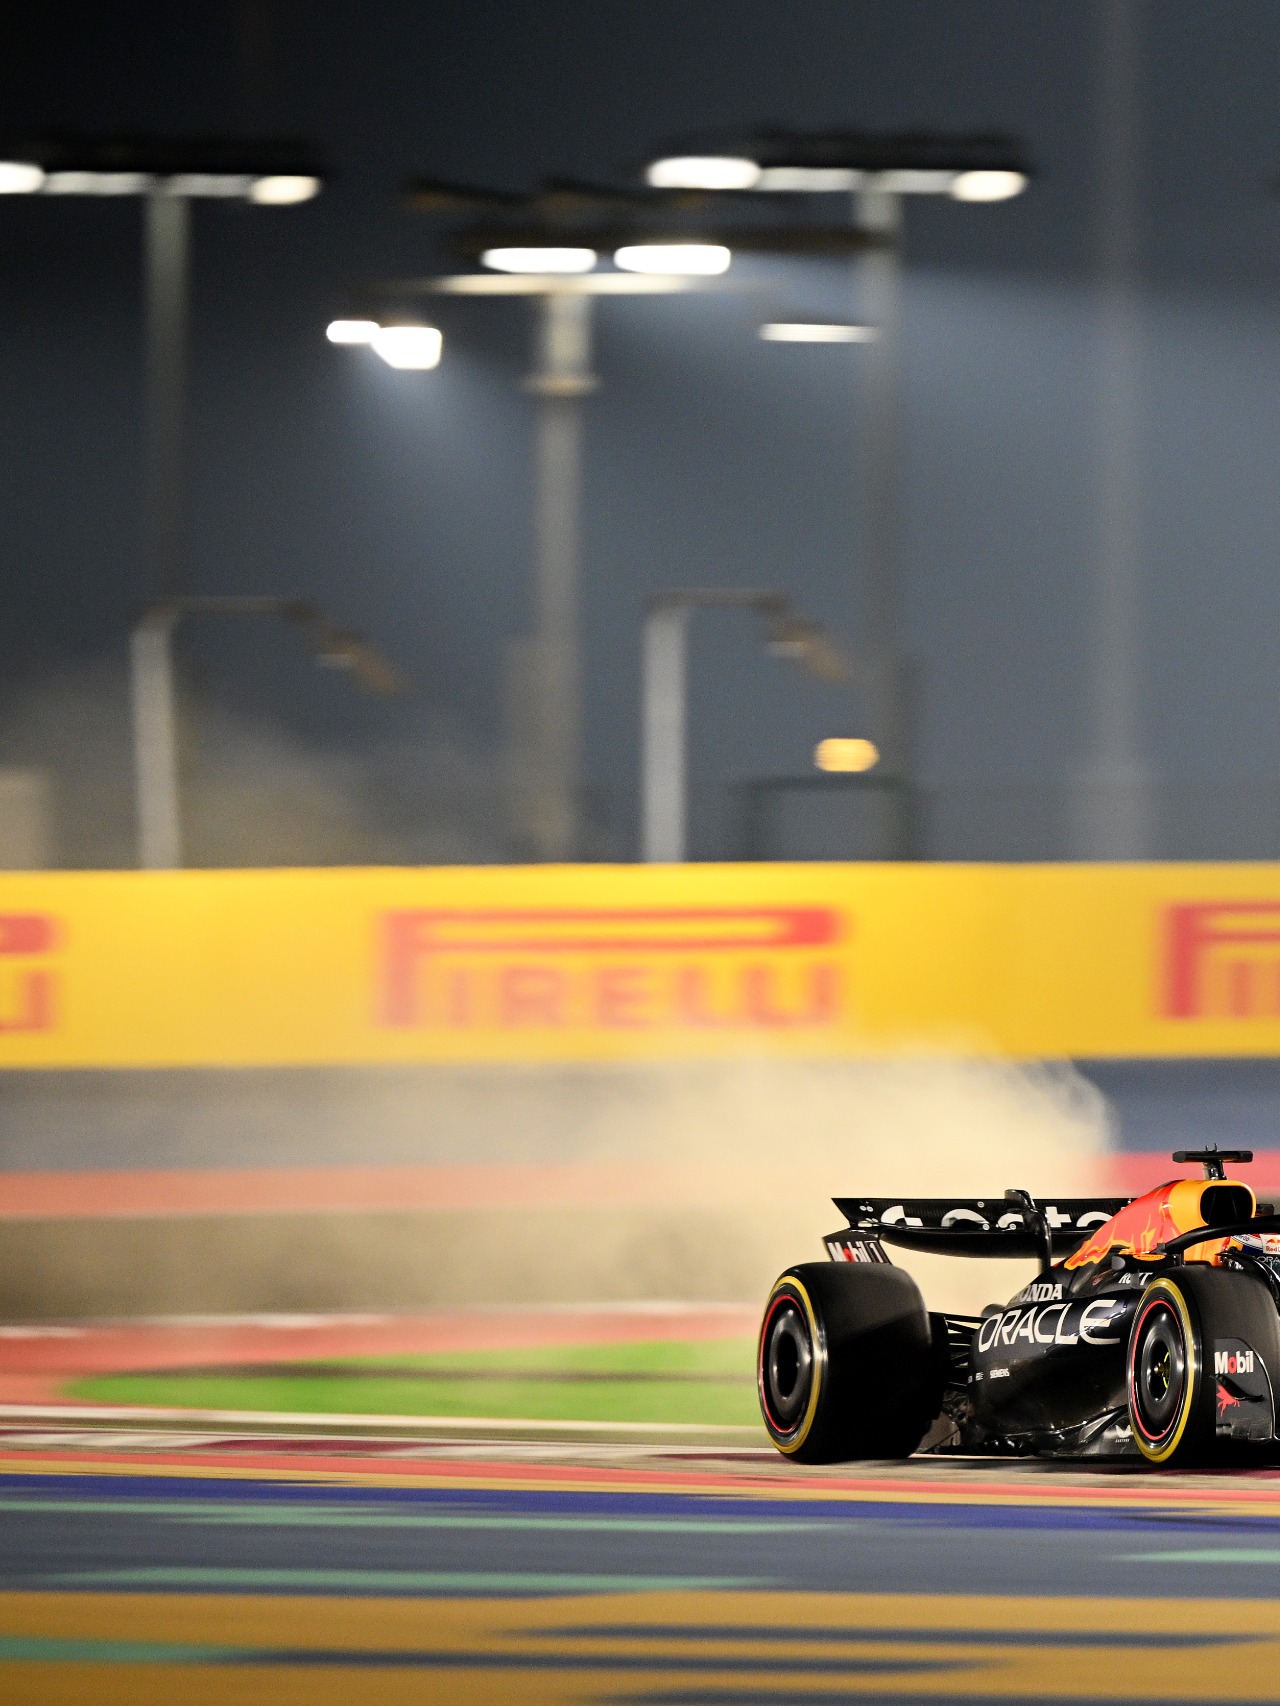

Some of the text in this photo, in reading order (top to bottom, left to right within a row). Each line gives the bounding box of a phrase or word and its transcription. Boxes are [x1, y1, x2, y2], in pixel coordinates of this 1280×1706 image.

[382, 908, 843, 1028] PIRELLI
[827, 1241, 870, 1262] Mobil
[1020, 1283, 1063, 1301] ONDA
[978, 1299, 1121, 1352] ORACLE
[1214, 1351, 1254, 1375] Mobil
